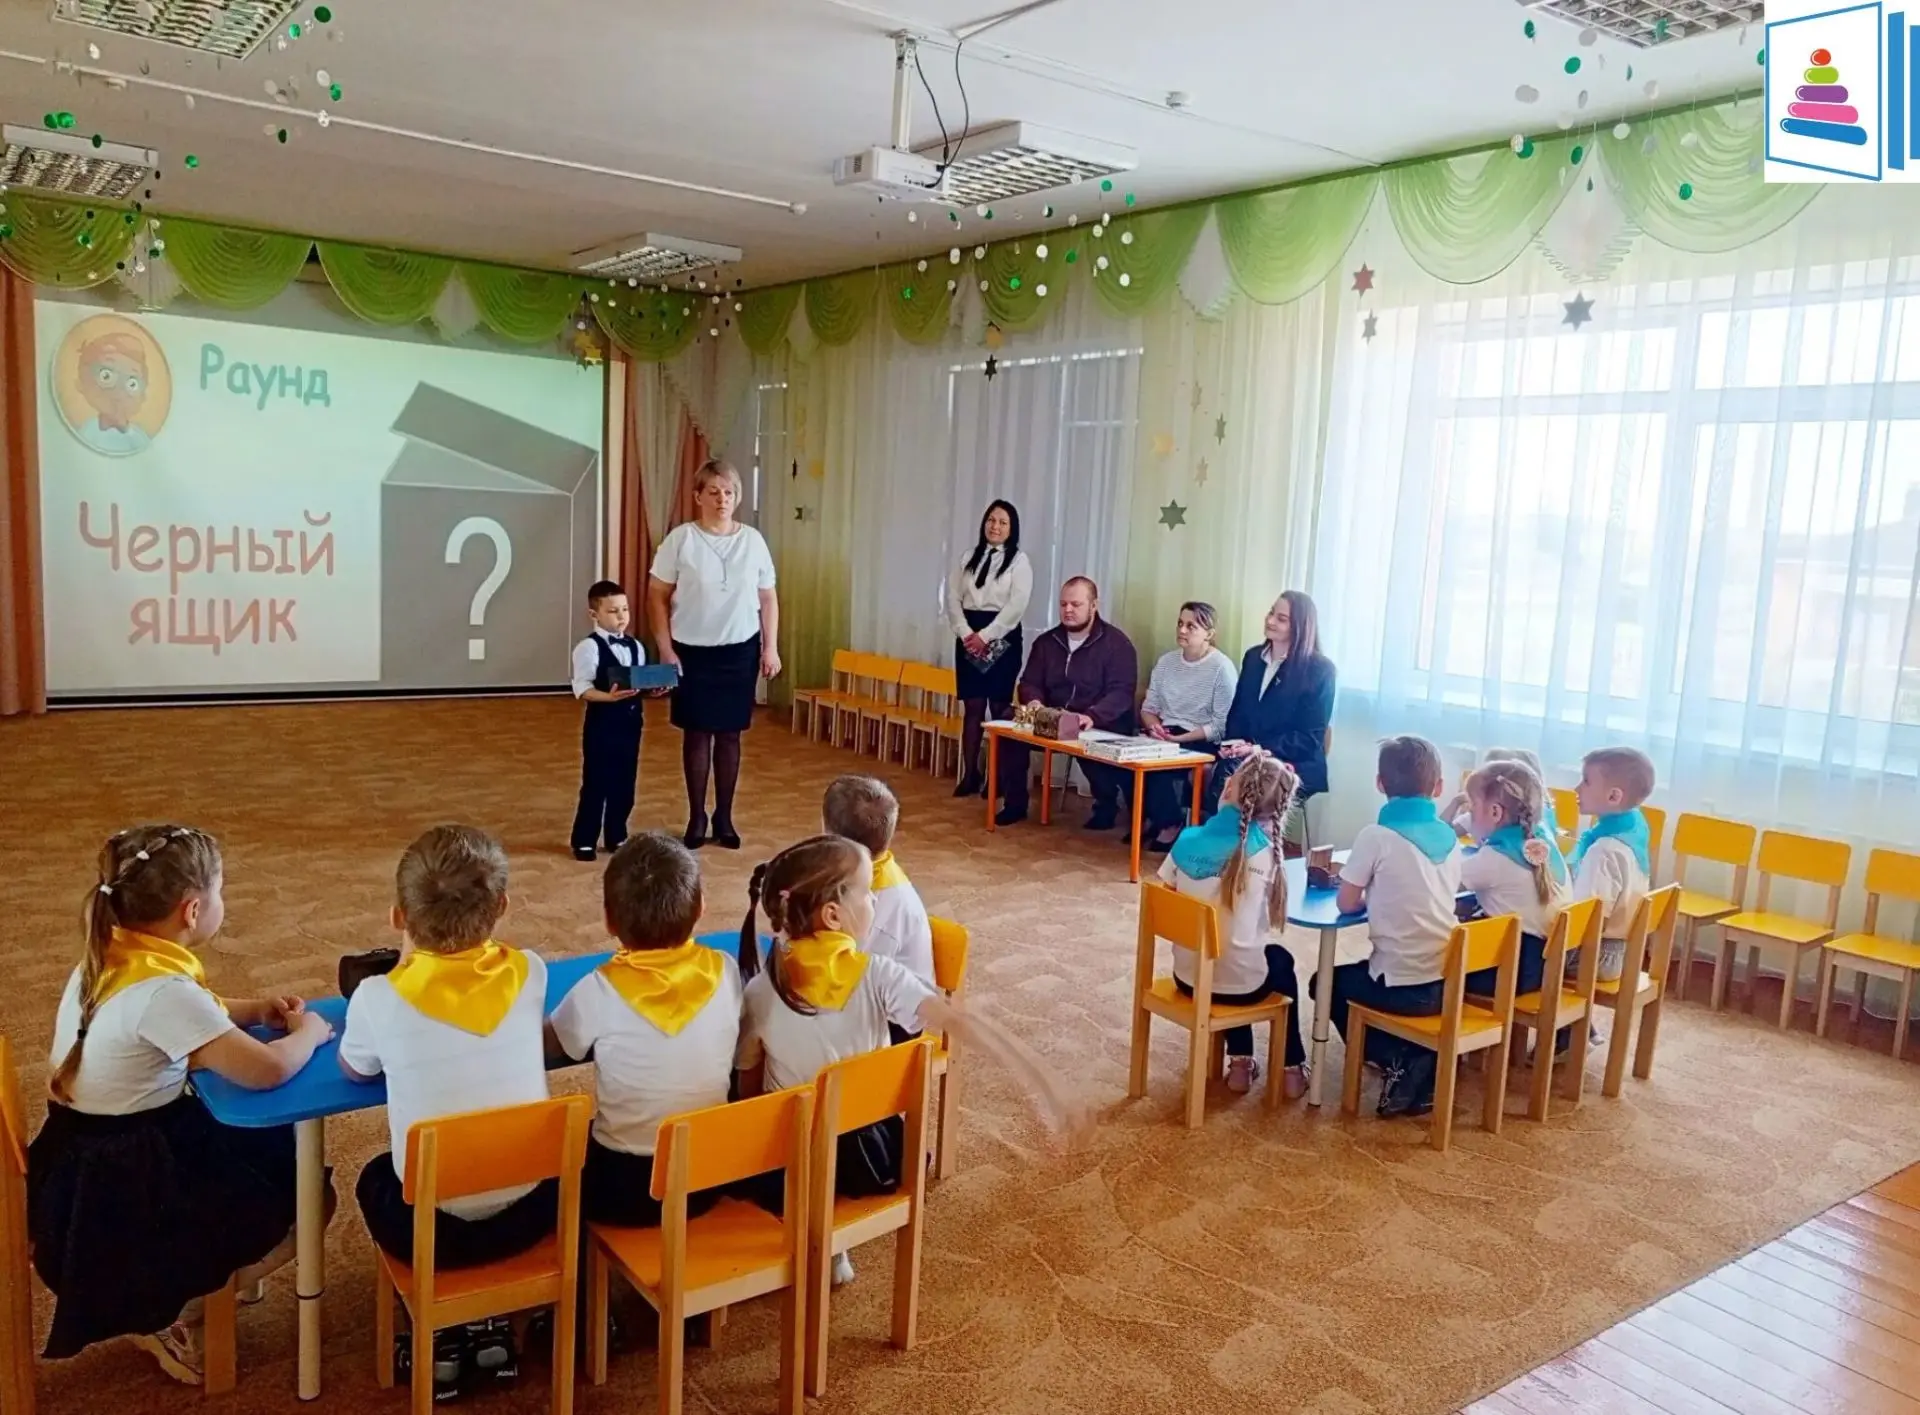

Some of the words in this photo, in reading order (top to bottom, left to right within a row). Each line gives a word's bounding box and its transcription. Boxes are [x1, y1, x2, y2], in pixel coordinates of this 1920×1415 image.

[200, 343, 331, 411] Раунд
[79, 501, 334, 595] Черный
[445, 516, 512, 660] ?
[128, 597, 297, 656] ящик
